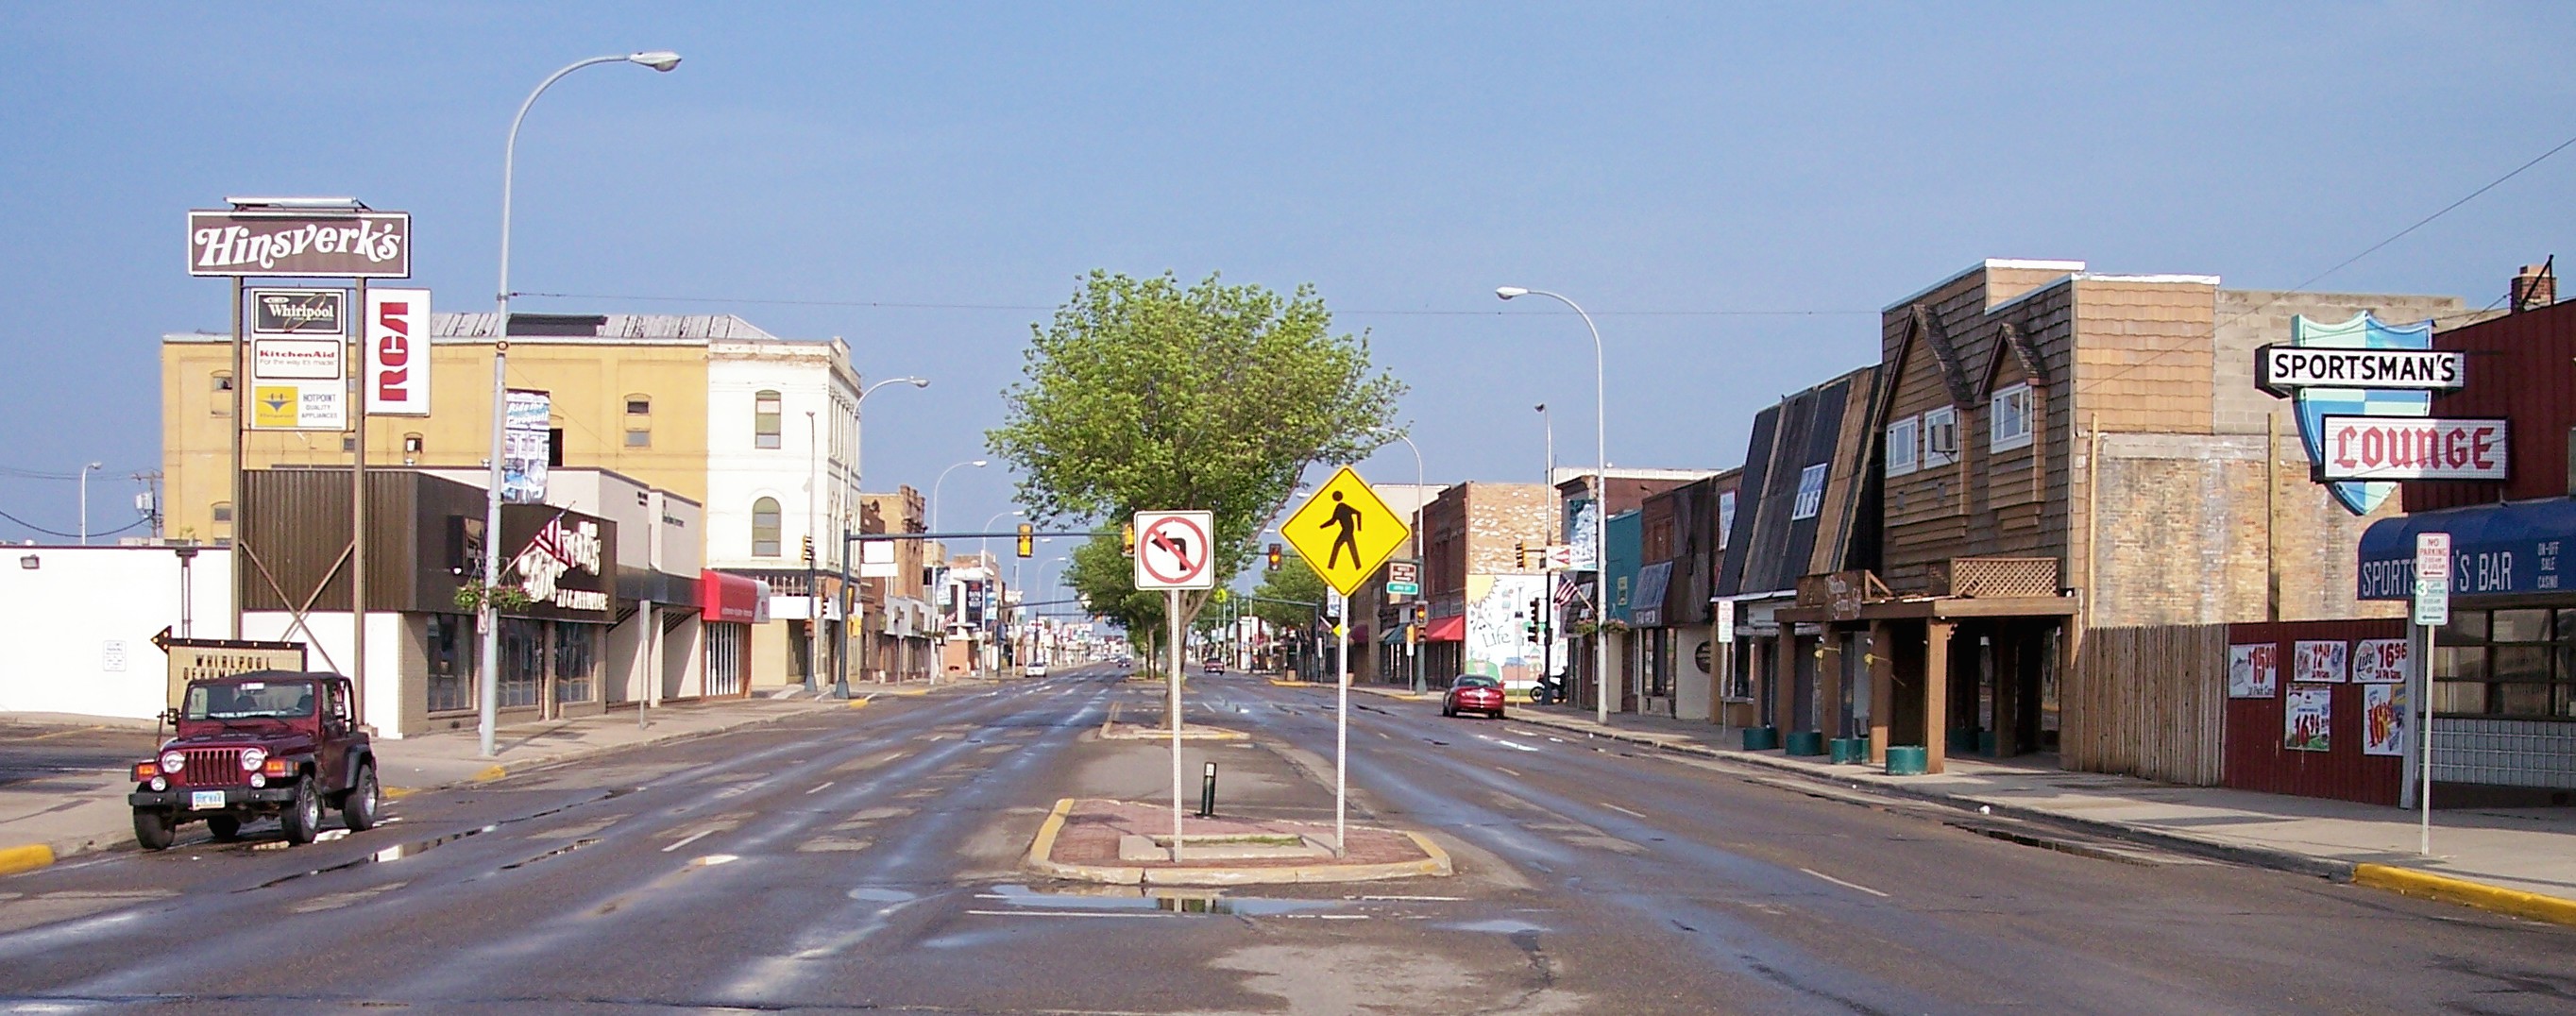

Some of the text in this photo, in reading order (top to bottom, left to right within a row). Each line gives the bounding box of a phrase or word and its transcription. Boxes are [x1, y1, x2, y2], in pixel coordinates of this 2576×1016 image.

[195, 220, 401, 269] Hinsverk's
[268, 303, 334, 321] Whirlpool
[260, 349, 335, 358] KitchenAid
[379, 301, 409, 401] RCA
[2275, 353, 2456, 381] SPORTSMAN'S
[303, 393, 336, 403] HOTPOINT
[2333, 425, 2495, 469] LOUNGE
[2428, 537, 2439, 547] NO
[2419, 548, 2447, 557] PARKING
[2478, 550, 2513, 592] BAR
[2541, 556, 2555, 570] SALE
[2537, 574, 2559, 589] CASINO
[196, 653, 271, 670] WHIRLPOOL
